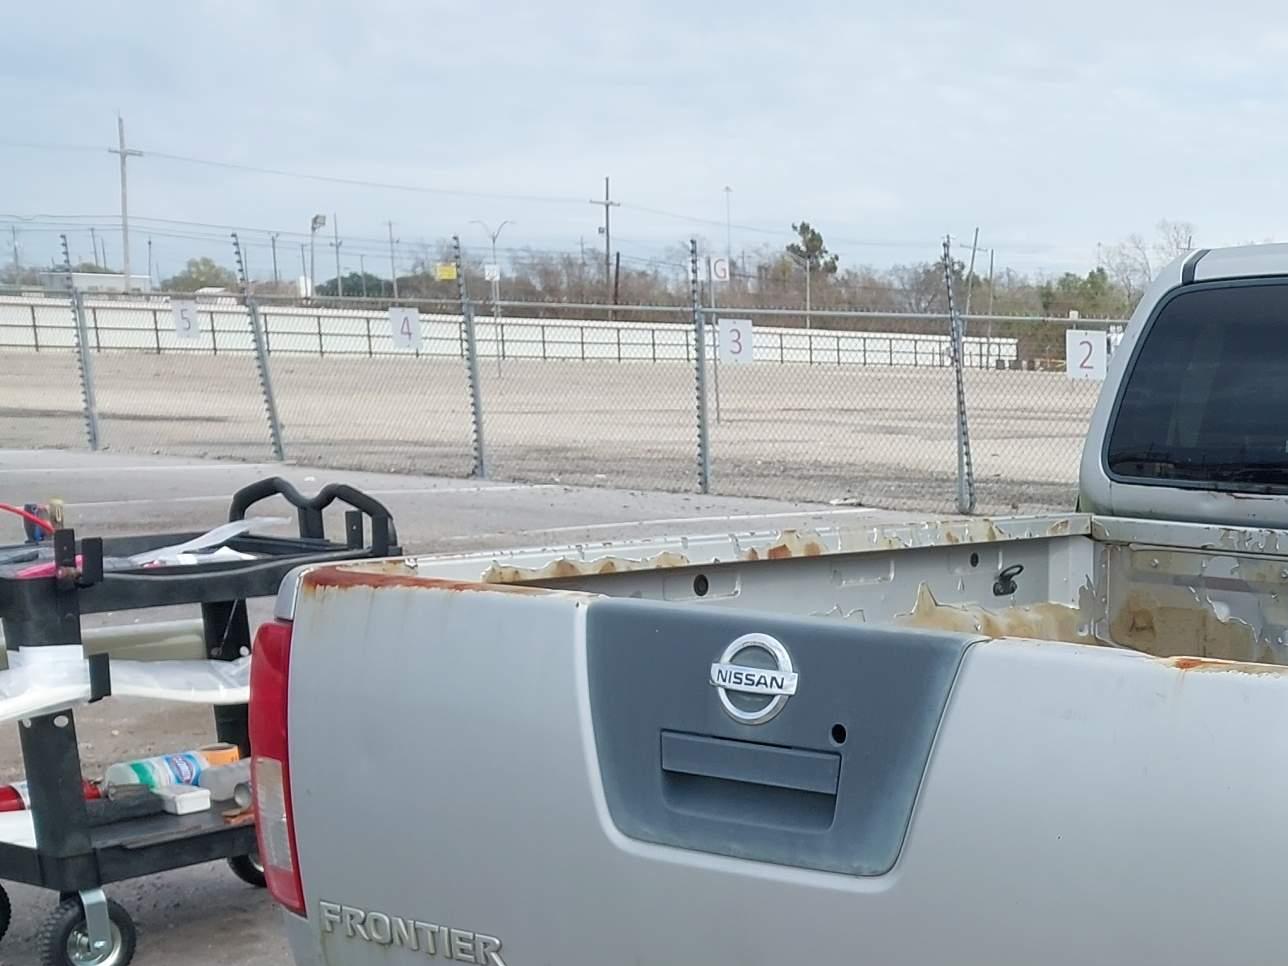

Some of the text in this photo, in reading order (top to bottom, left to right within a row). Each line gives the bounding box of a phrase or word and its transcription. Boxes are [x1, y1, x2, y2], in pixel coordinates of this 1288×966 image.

[714, 258, 728, 280] G
[180, 308, 191, 331] 5
[400, 316, 412, 341] 4
[729, 328, 743, 355] 3
[1079, 340, 1095, 369] 2
[716, 668, 785, 690] NISSAN
